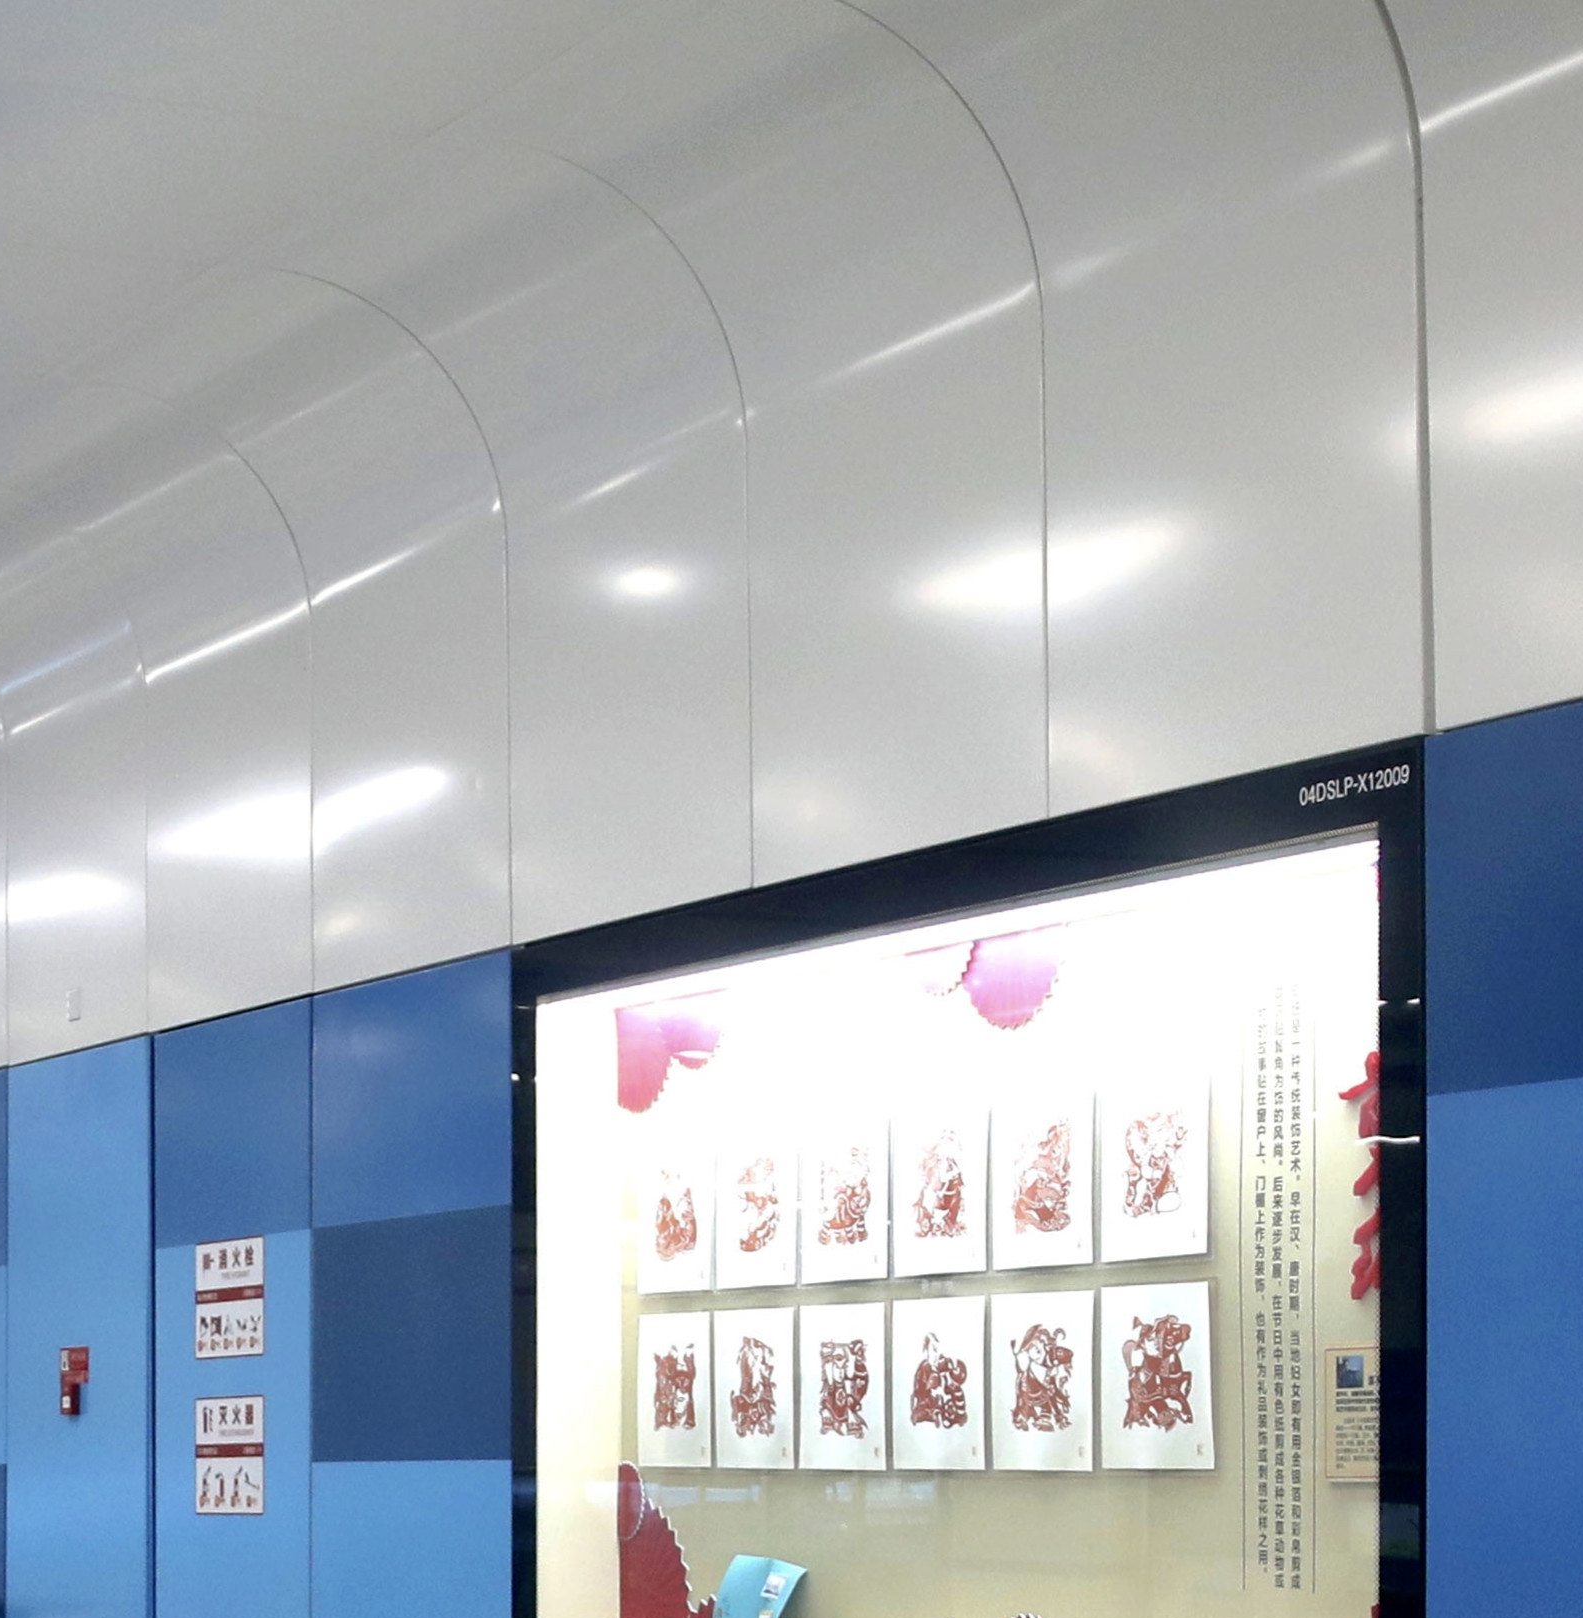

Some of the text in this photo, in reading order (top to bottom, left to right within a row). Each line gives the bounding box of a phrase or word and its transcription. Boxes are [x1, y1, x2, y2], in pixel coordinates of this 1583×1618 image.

[1299, 764, 1410, 806] 04DSLP-X12009
[219, 1404, 254, 1426] 灭火器
